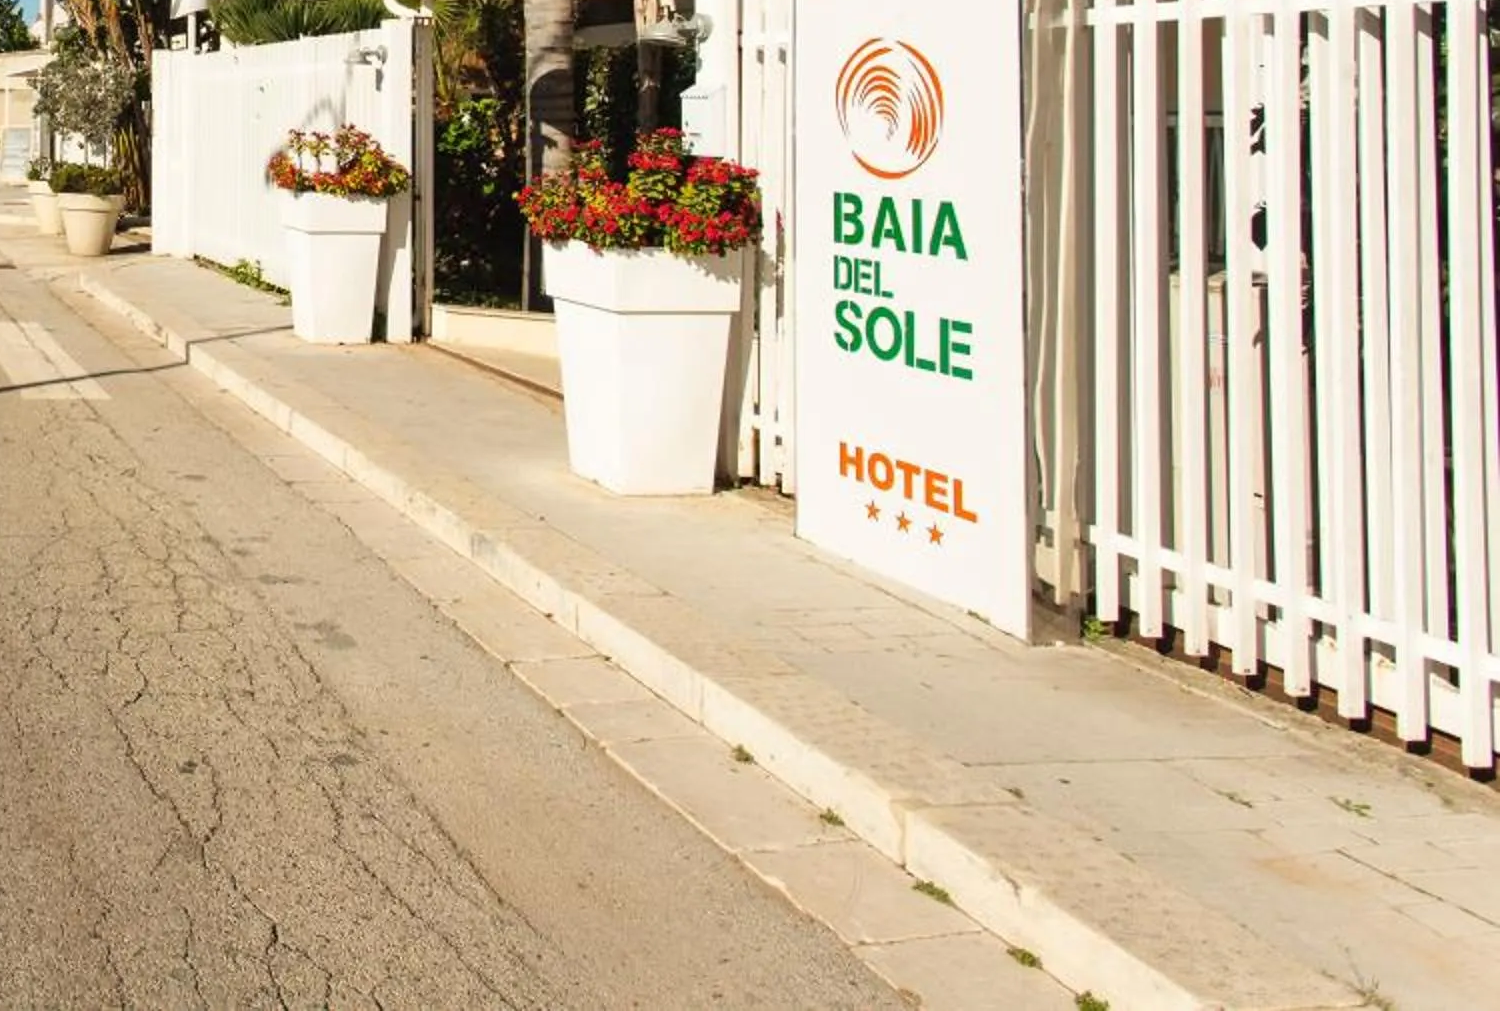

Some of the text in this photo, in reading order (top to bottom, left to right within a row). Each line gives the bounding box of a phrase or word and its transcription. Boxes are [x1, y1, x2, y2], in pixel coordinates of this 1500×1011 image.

[834, 192, 969, 260] BAIA
[834, 256, 895, 298] DEL
[834, 300, 974, 381] SOLE
[839, 443, 978, 523] HOTEL
